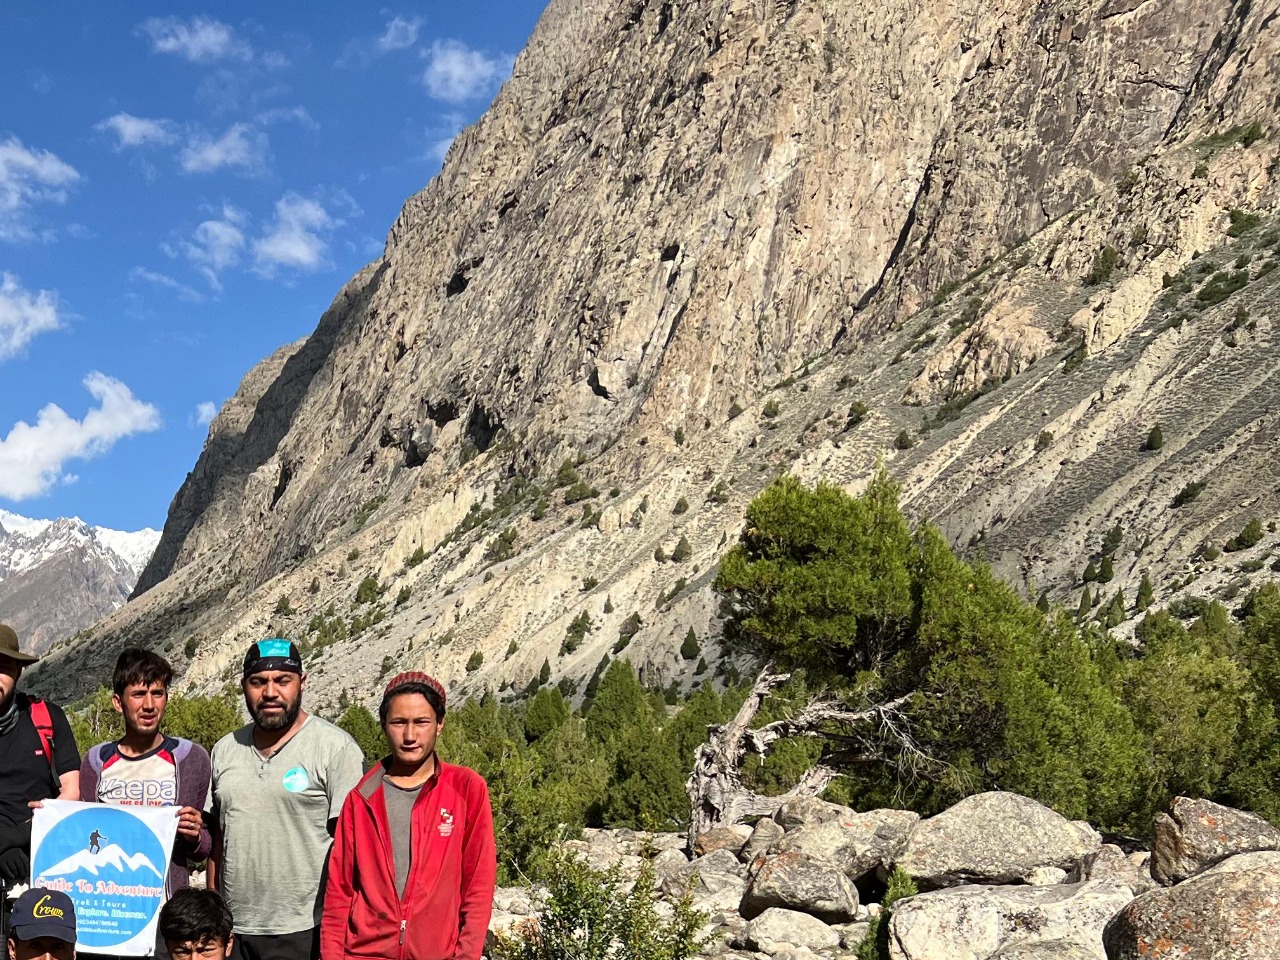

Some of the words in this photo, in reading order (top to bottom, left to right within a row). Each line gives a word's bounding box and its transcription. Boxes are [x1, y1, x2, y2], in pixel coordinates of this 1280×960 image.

[97, 779, 176, 804] Kaepa
[35, 876, 73, 892] Guide
[75, 878, 94, 894] To
[94, 880, 163, 898] Adventure
